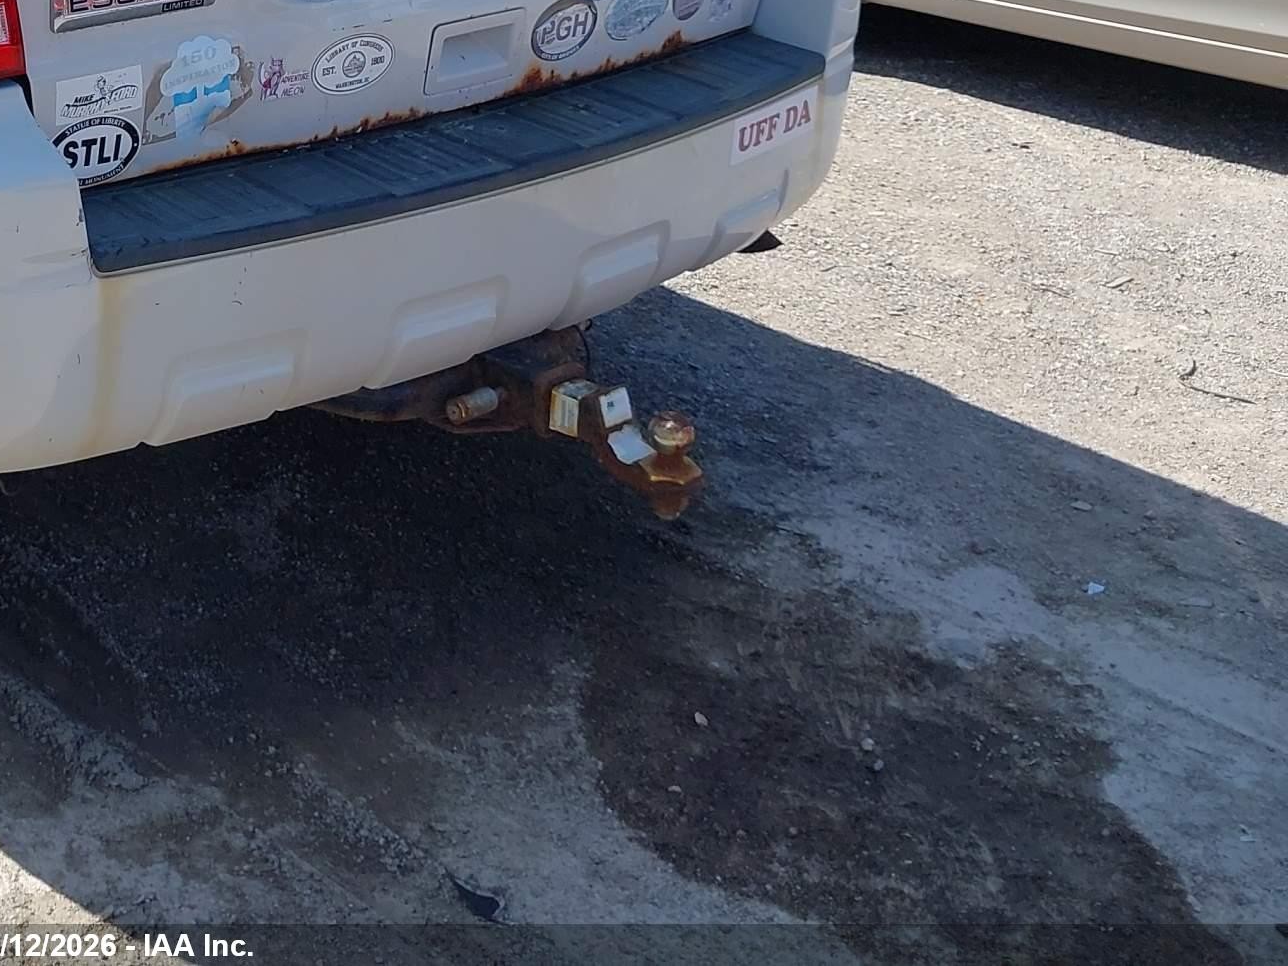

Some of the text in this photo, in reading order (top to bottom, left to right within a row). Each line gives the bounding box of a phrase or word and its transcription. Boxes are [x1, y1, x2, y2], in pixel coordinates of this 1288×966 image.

[540, 11, 589, 44] PGH
[181, 46, 217, 67] 150
[325, 43, 349, 63] LIBRARY
[281, 72, 310, 84] ADVENTURE
[322, 66, 336, 76] EST.
[74, 93, 96, 104] MIKE
[281, 86, 305, 97] MEOW
[60, 100, 104, 118] MURPHY
[108, 86, 138, 103] FORD
[65, 117, 126, 136] STATUE OF LIBERTY
[738, 99, 811, 152] UFF DA
[63, 134, 122, 169] STLI
